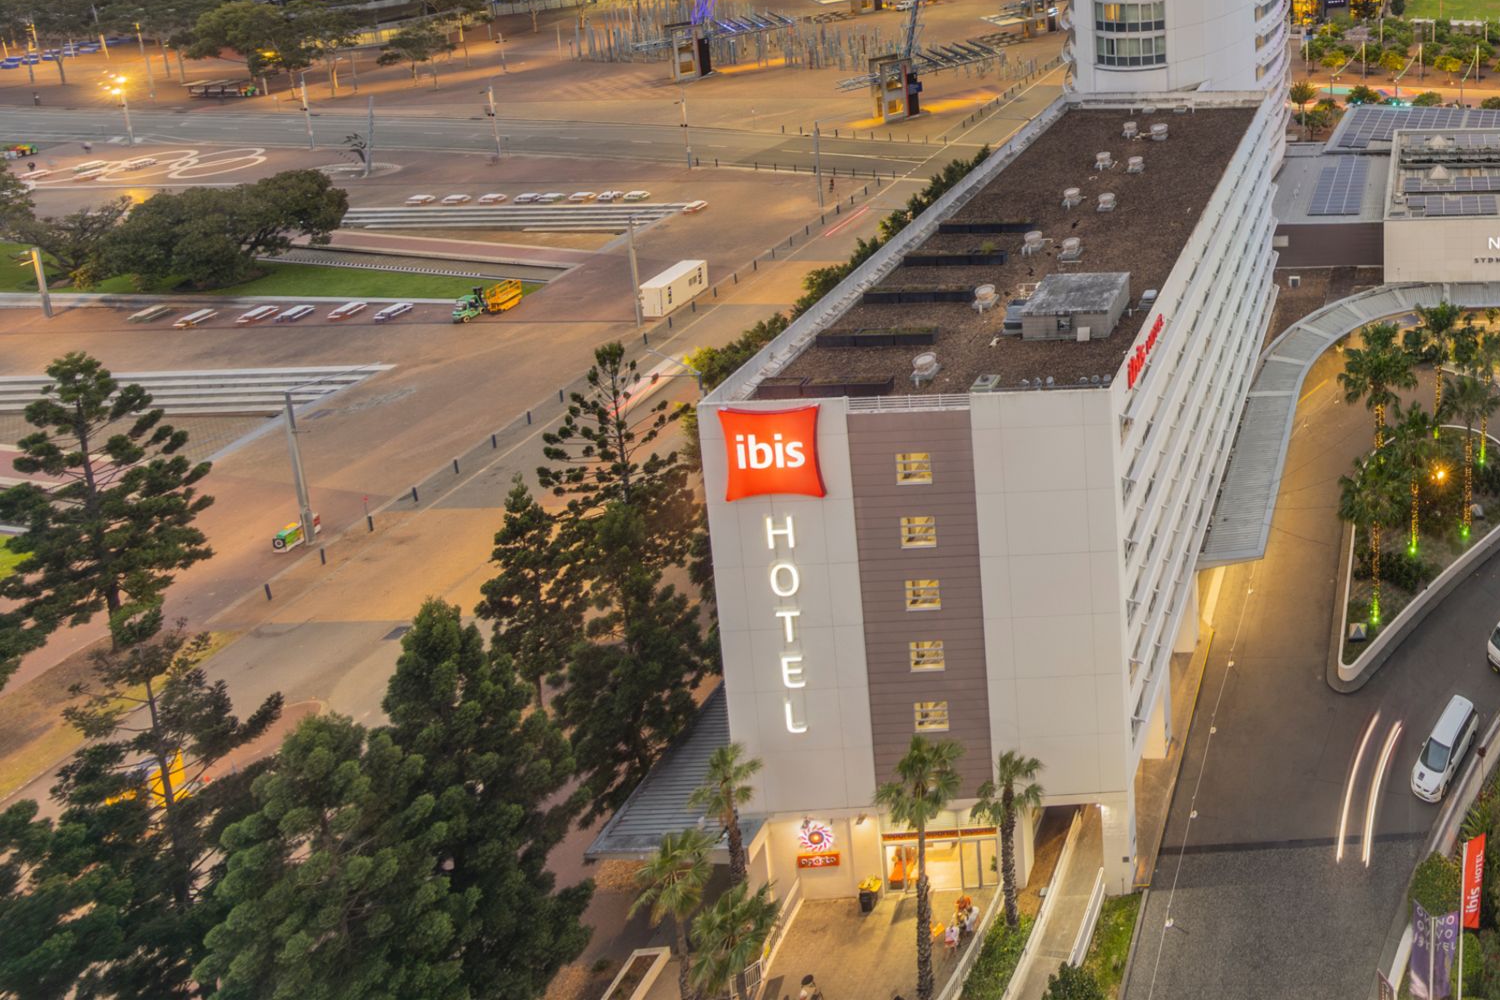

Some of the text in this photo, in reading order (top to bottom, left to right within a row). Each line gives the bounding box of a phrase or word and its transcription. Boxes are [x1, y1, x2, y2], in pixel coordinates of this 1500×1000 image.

[735, 433, 806, 470] ibis
[765, 515, 808, 733] HOTEL
[1466, 849, 1484, 914] ibis HOTEL
